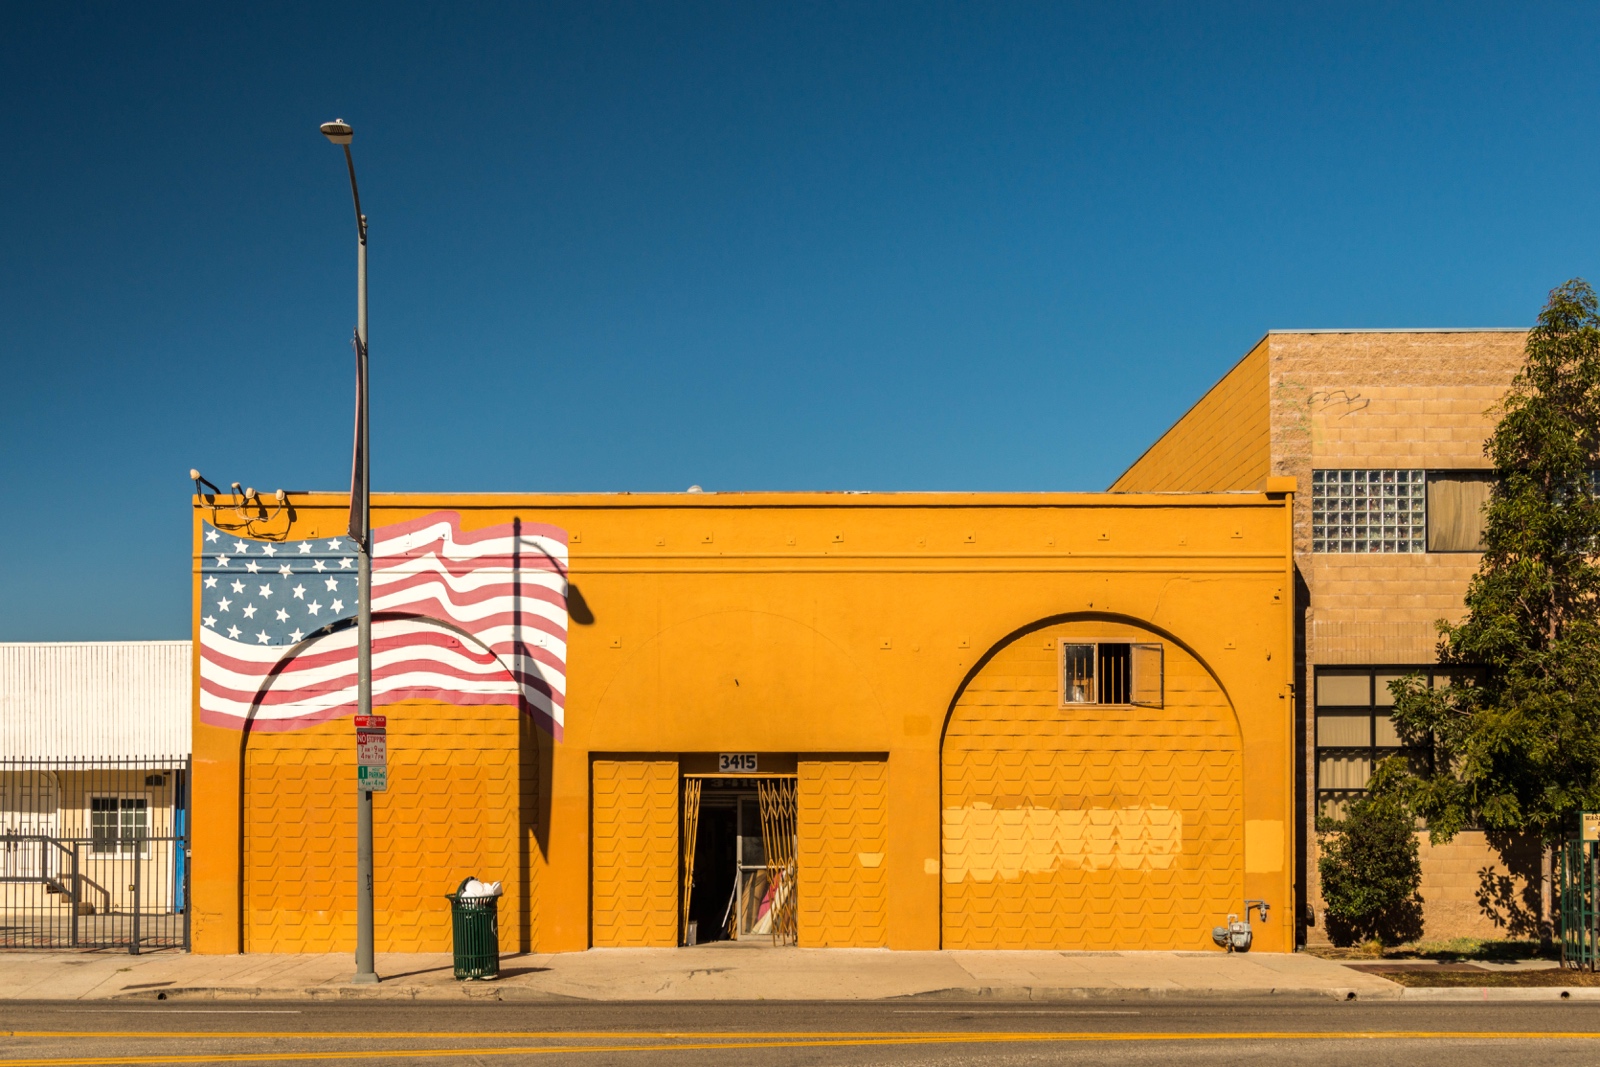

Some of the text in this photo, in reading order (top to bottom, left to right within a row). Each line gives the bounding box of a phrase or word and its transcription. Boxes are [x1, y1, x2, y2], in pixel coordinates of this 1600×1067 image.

[358, 735, 386, 744] NO STOPPING
[721, 755, 756, 769] 3415
[710, 778, 758, 787] 3415
